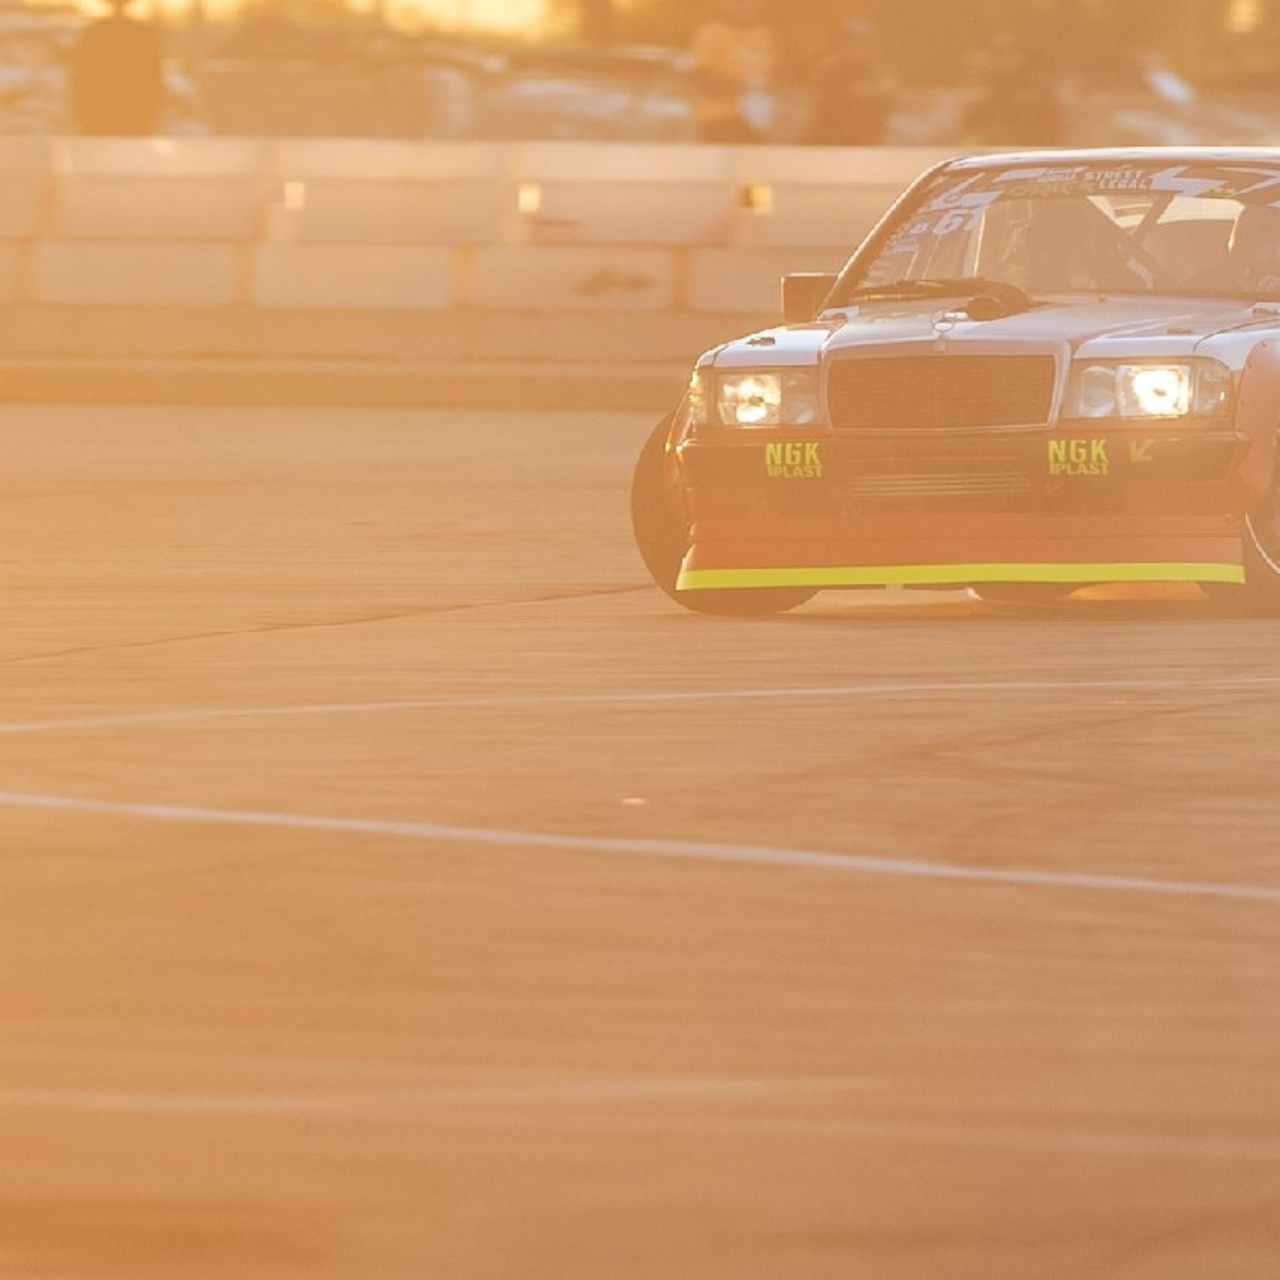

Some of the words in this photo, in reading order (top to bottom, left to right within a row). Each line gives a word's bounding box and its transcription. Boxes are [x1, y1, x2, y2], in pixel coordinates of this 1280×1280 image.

[1084, 169, 1145, 181] STREET
[1099, 178, 1147, 190] LEGAL
[765, 442, 821, 465] NGK
[1048, 439, 1107, 463] NGK
